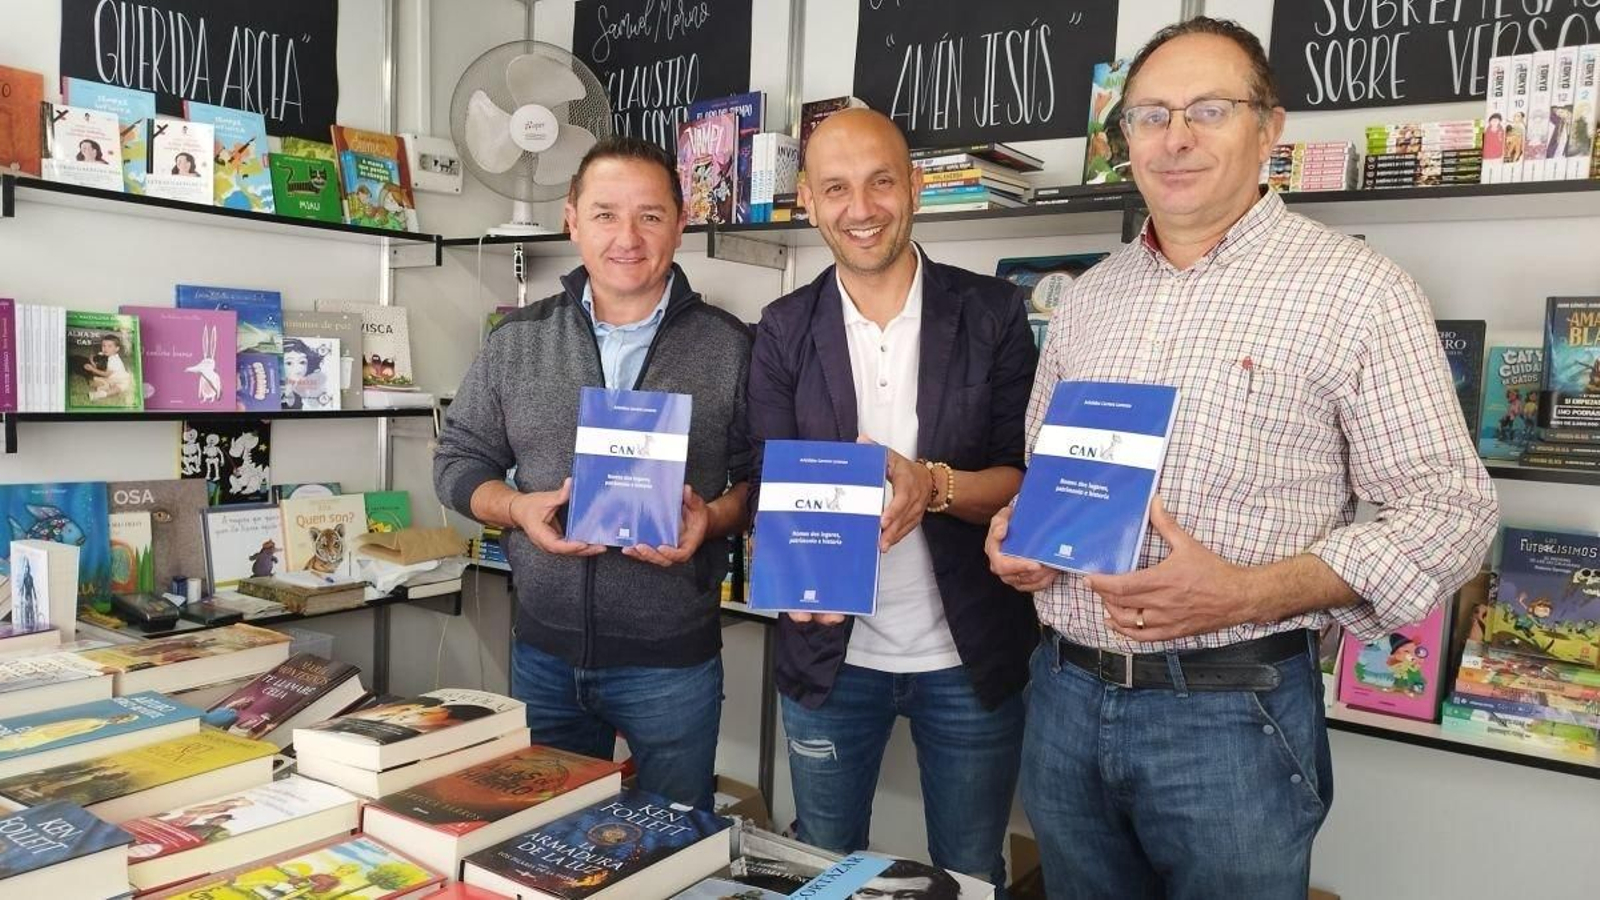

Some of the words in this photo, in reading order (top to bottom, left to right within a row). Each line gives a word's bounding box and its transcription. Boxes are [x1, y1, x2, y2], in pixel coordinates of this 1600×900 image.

[94, 0, 211, 104] QUERIDA
[1305, 32, 1410, 105] SOBRE
[300, 201, 320, 212] MIAU
[610, 444, 634, 456] CAN
[1069, 444, 1098, 458] CAN
[114, 489, 156, 505] OSA
[795, 499, 823, 510] CAN
[296, 514, 326, 528] Quen
[329, 512, 354, 524] son?
[600, 802, 694, 838] FOLLETT
[638, 804, 685, 824] KEN
[0, 816, 69, 854] FOLLETT
[37, 818, 84, 840] KEN
[516, 842, 545, 856] DE
[541, 852, 566, 865] LA
[564, 860, 601, 874] LUZ
[524, 831, 625, 870] ARMADURA
